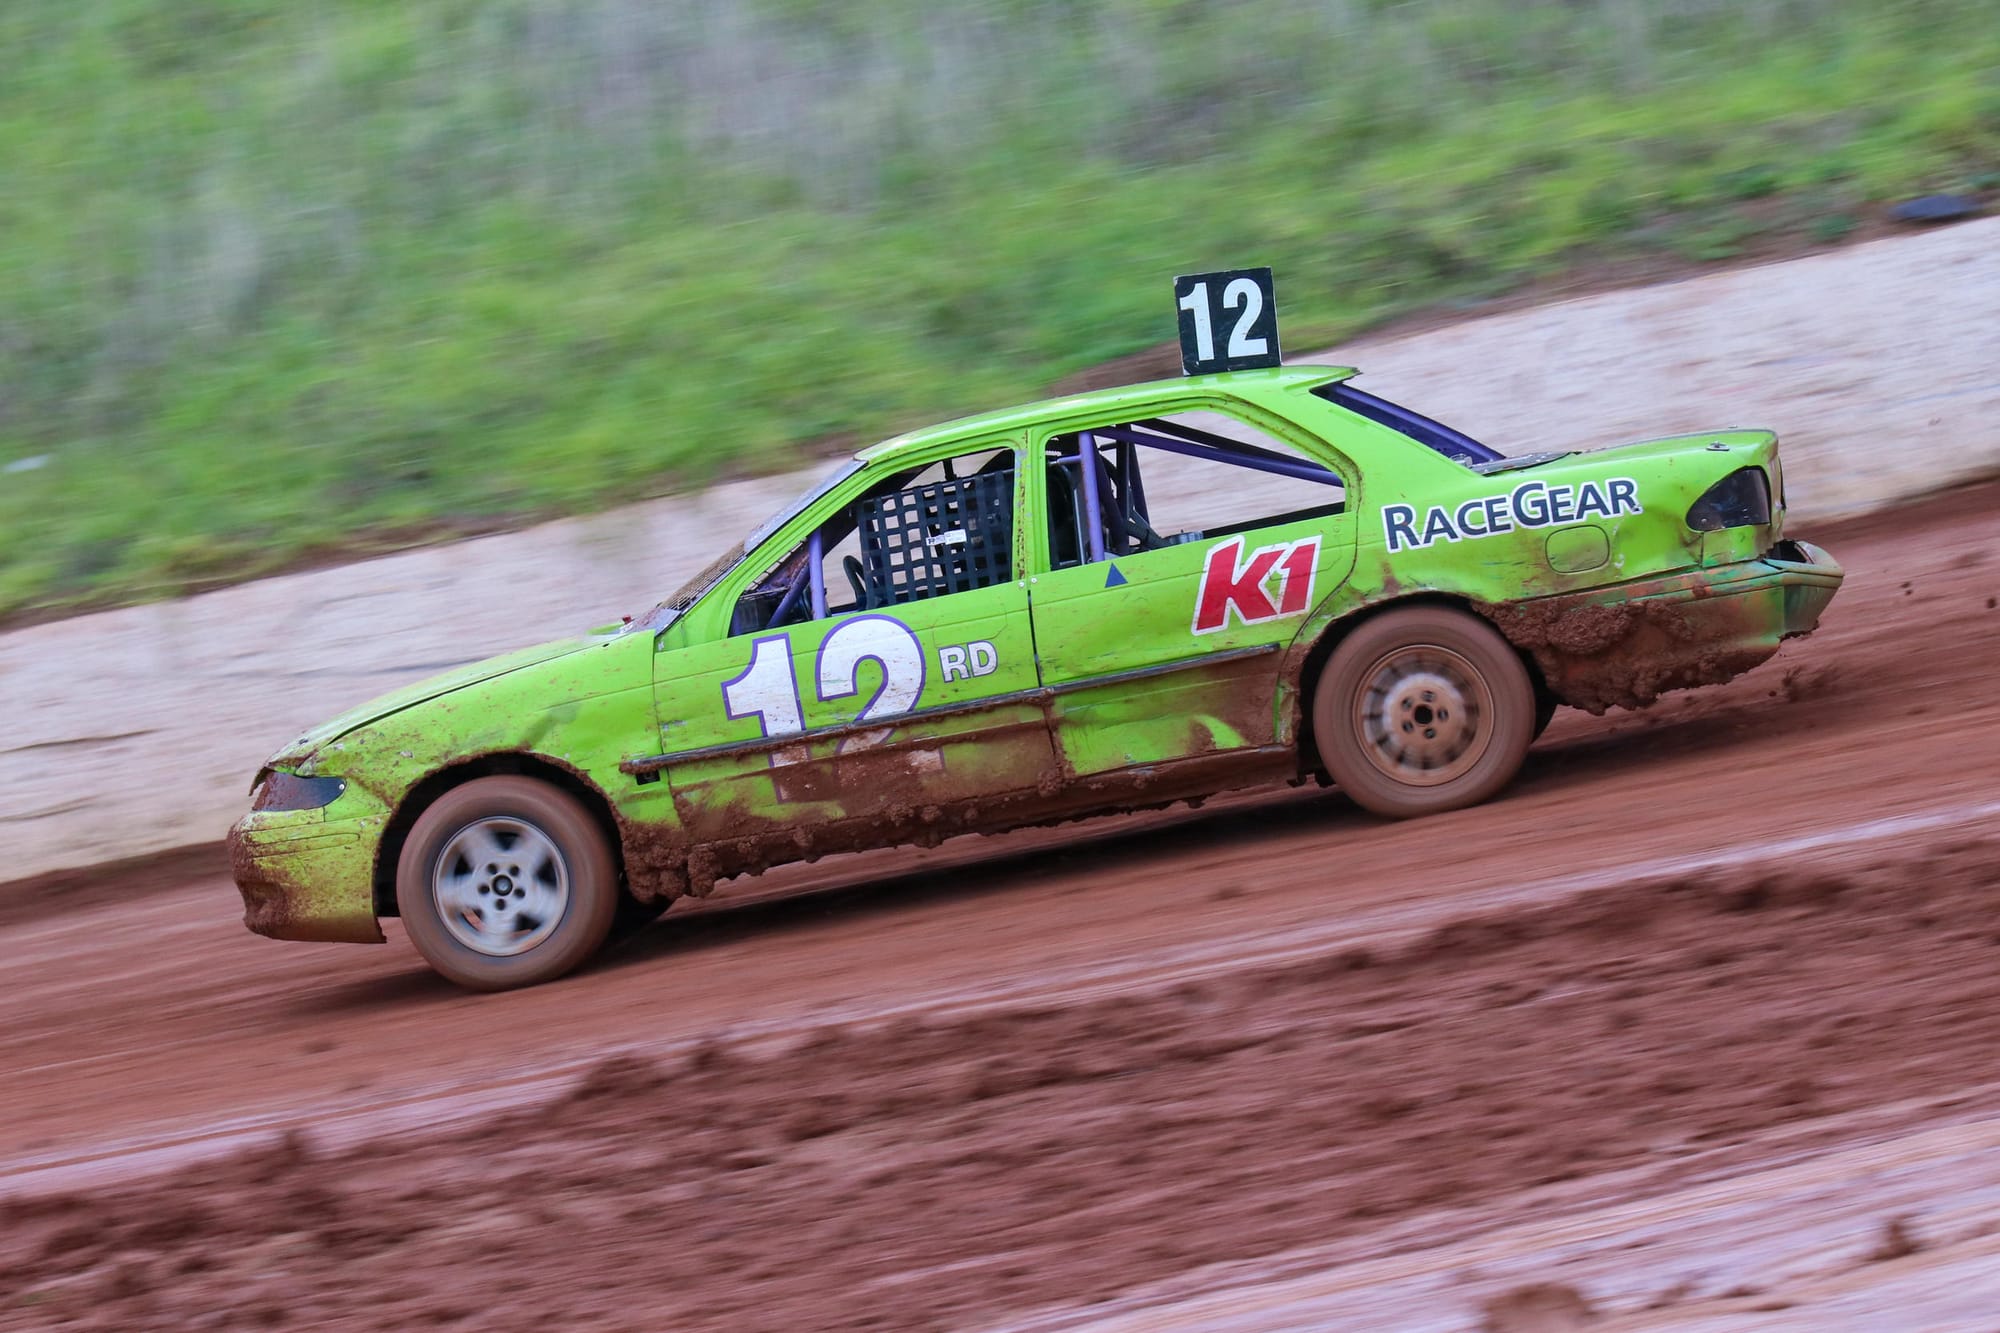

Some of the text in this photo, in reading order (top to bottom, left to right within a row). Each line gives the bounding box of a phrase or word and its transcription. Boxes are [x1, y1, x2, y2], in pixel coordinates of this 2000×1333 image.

[1179, 278, 1268, 361] 12
[1382, 477, 1643, 552] RACEGEAR
[1192, 535, 1322, 635] K1
[721, 614, 998, 804] 12 RD
